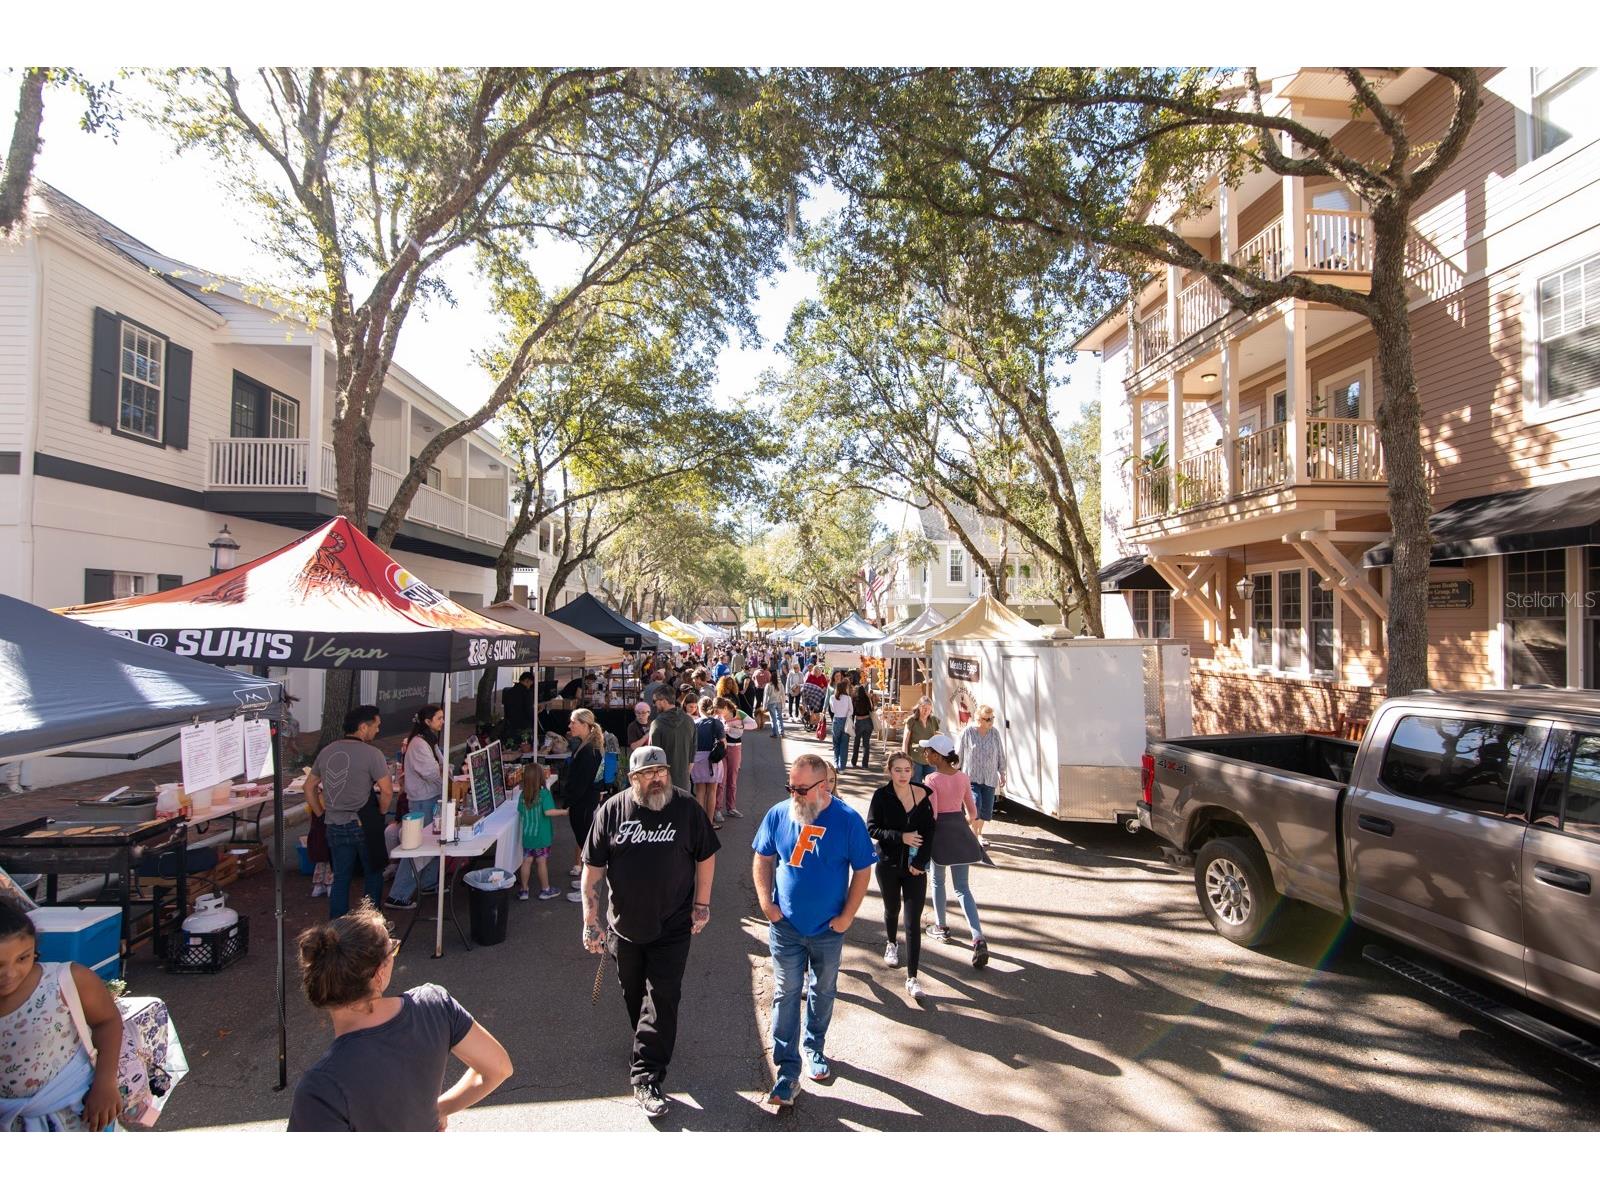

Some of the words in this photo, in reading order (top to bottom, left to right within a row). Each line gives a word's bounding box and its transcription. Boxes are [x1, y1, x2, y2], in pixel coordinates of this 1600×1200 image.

[175, 629, 294, 660] SUKI'S
[302, 636, 389, 667] Vegan
[494, 639, 517, 661] SUKI'S
[949, 660, 962, 670] Meats
[615, 820, 677, 844] Florida
[785, 824, 827, 869] F
